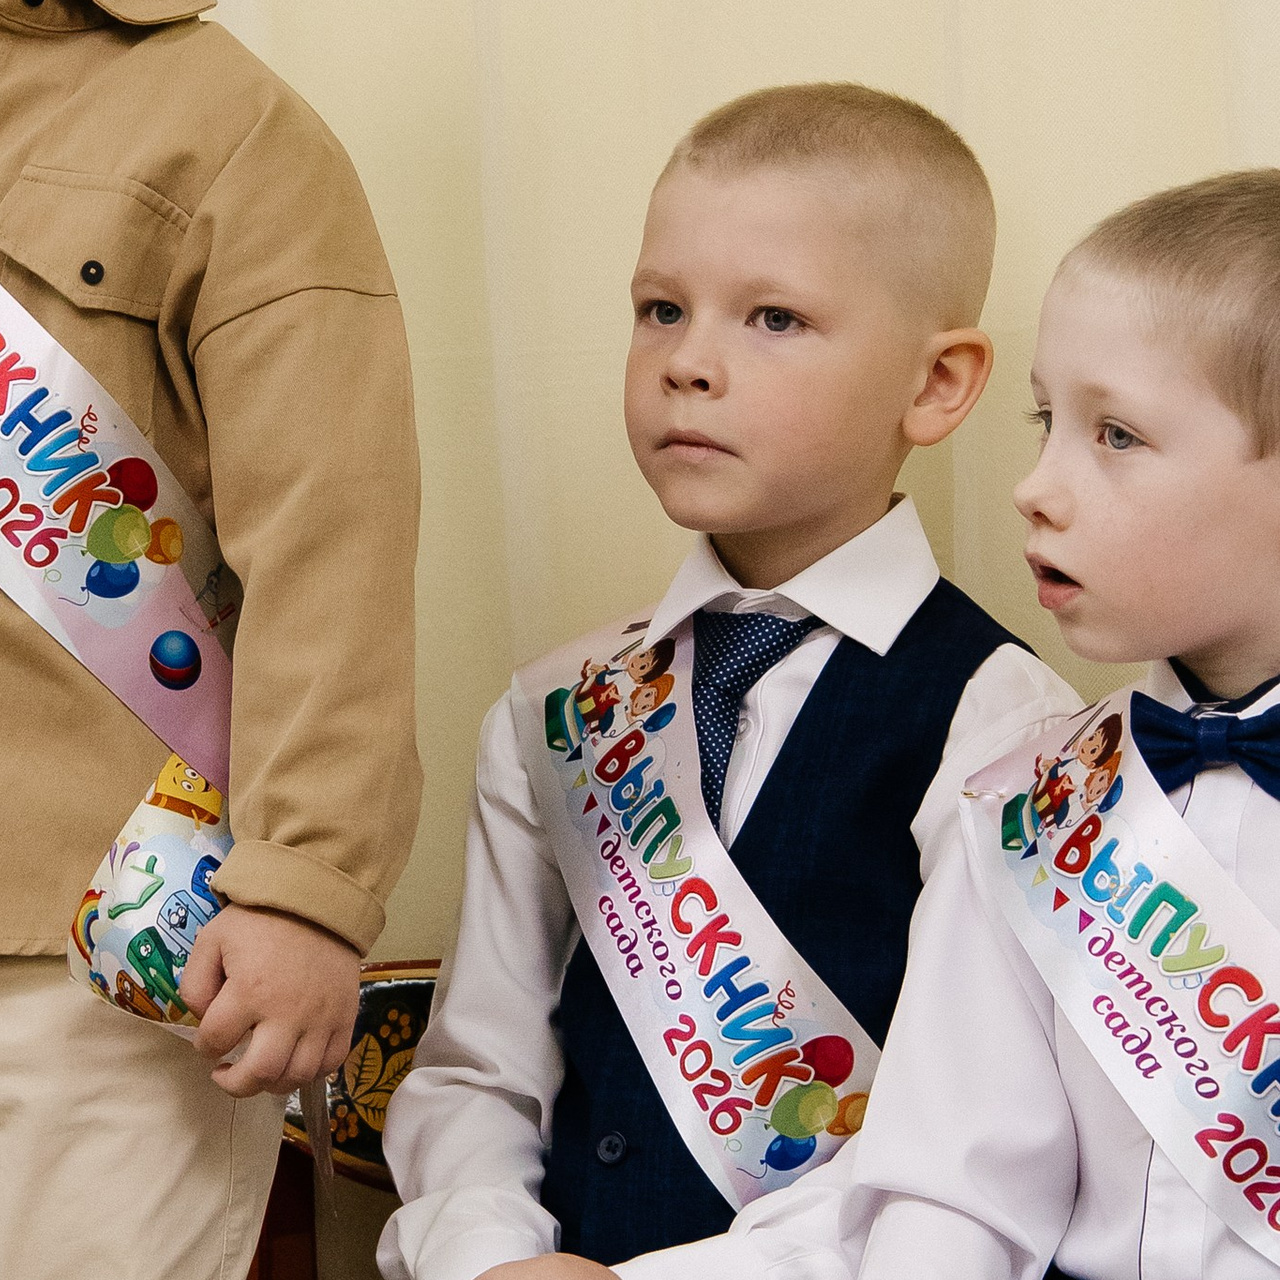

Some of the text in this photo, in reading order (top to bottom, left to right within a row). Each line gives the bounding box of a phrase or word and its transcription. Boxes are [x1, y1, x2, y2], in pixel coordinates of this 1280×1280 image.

[593, 728, 812, 1107] ВЫПУСКНИК
[598, 895, 644, 979] сада
[599, 831, 682, 1001] детского
[1053, 812, 1280, 1125] ВЫПУСК
[663, 1014, 753, 1136] 2026
[1087, 926, 1221, 1099] детского
[1092, 993, 1163, 1080] сада
